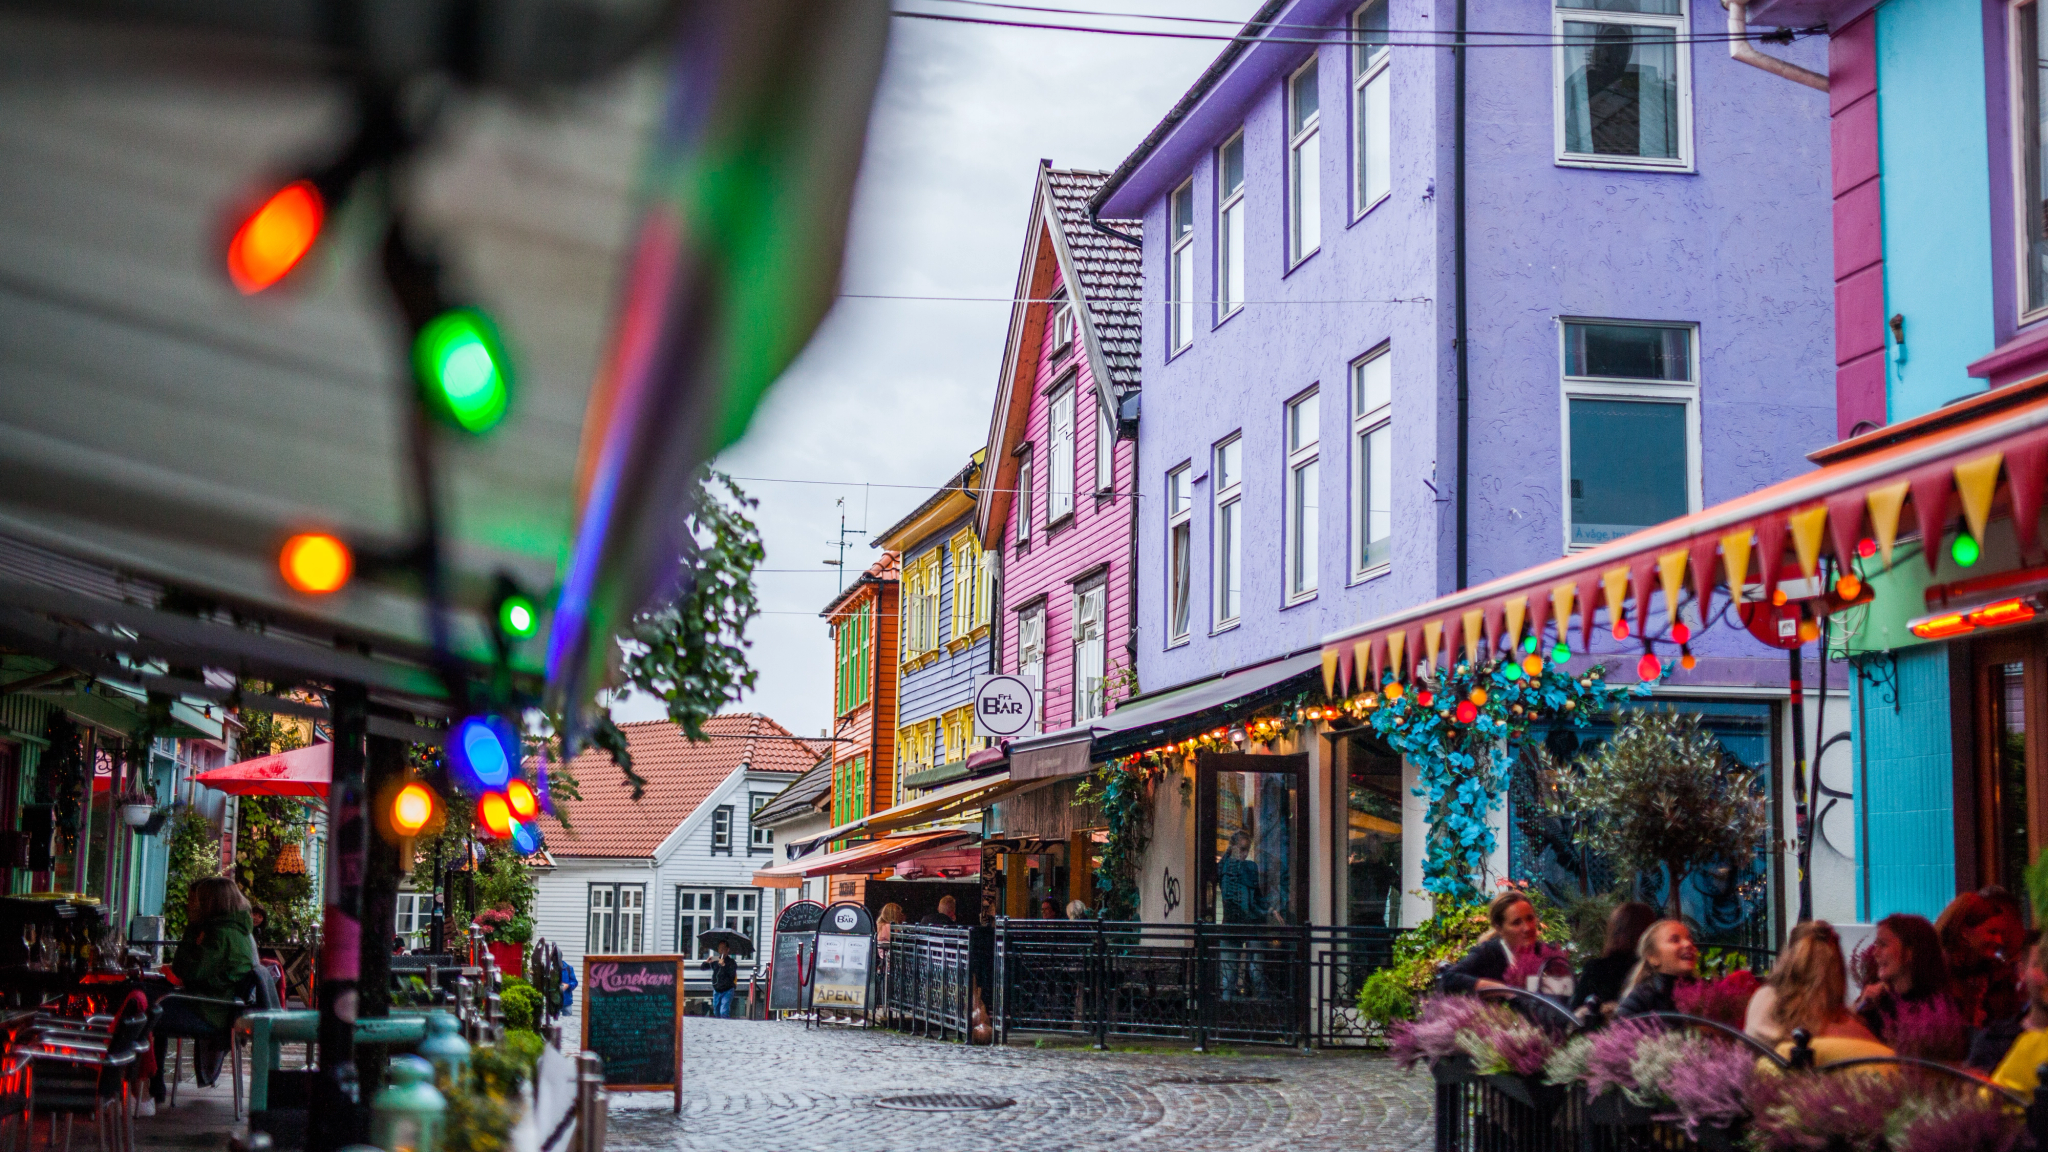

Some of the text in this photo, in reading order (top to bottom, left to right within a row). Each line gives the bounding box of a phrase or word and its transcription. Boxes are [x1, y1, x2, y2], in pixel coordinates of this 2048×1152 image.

[1576, 526, 1583, 538] Å
[983, 697, 1023, 715] BAR
[837, 915, 854, 923] BAR
[589, 962, 673, 993] Hanekam
[817, 985, 862, 1002] ÅPENT
